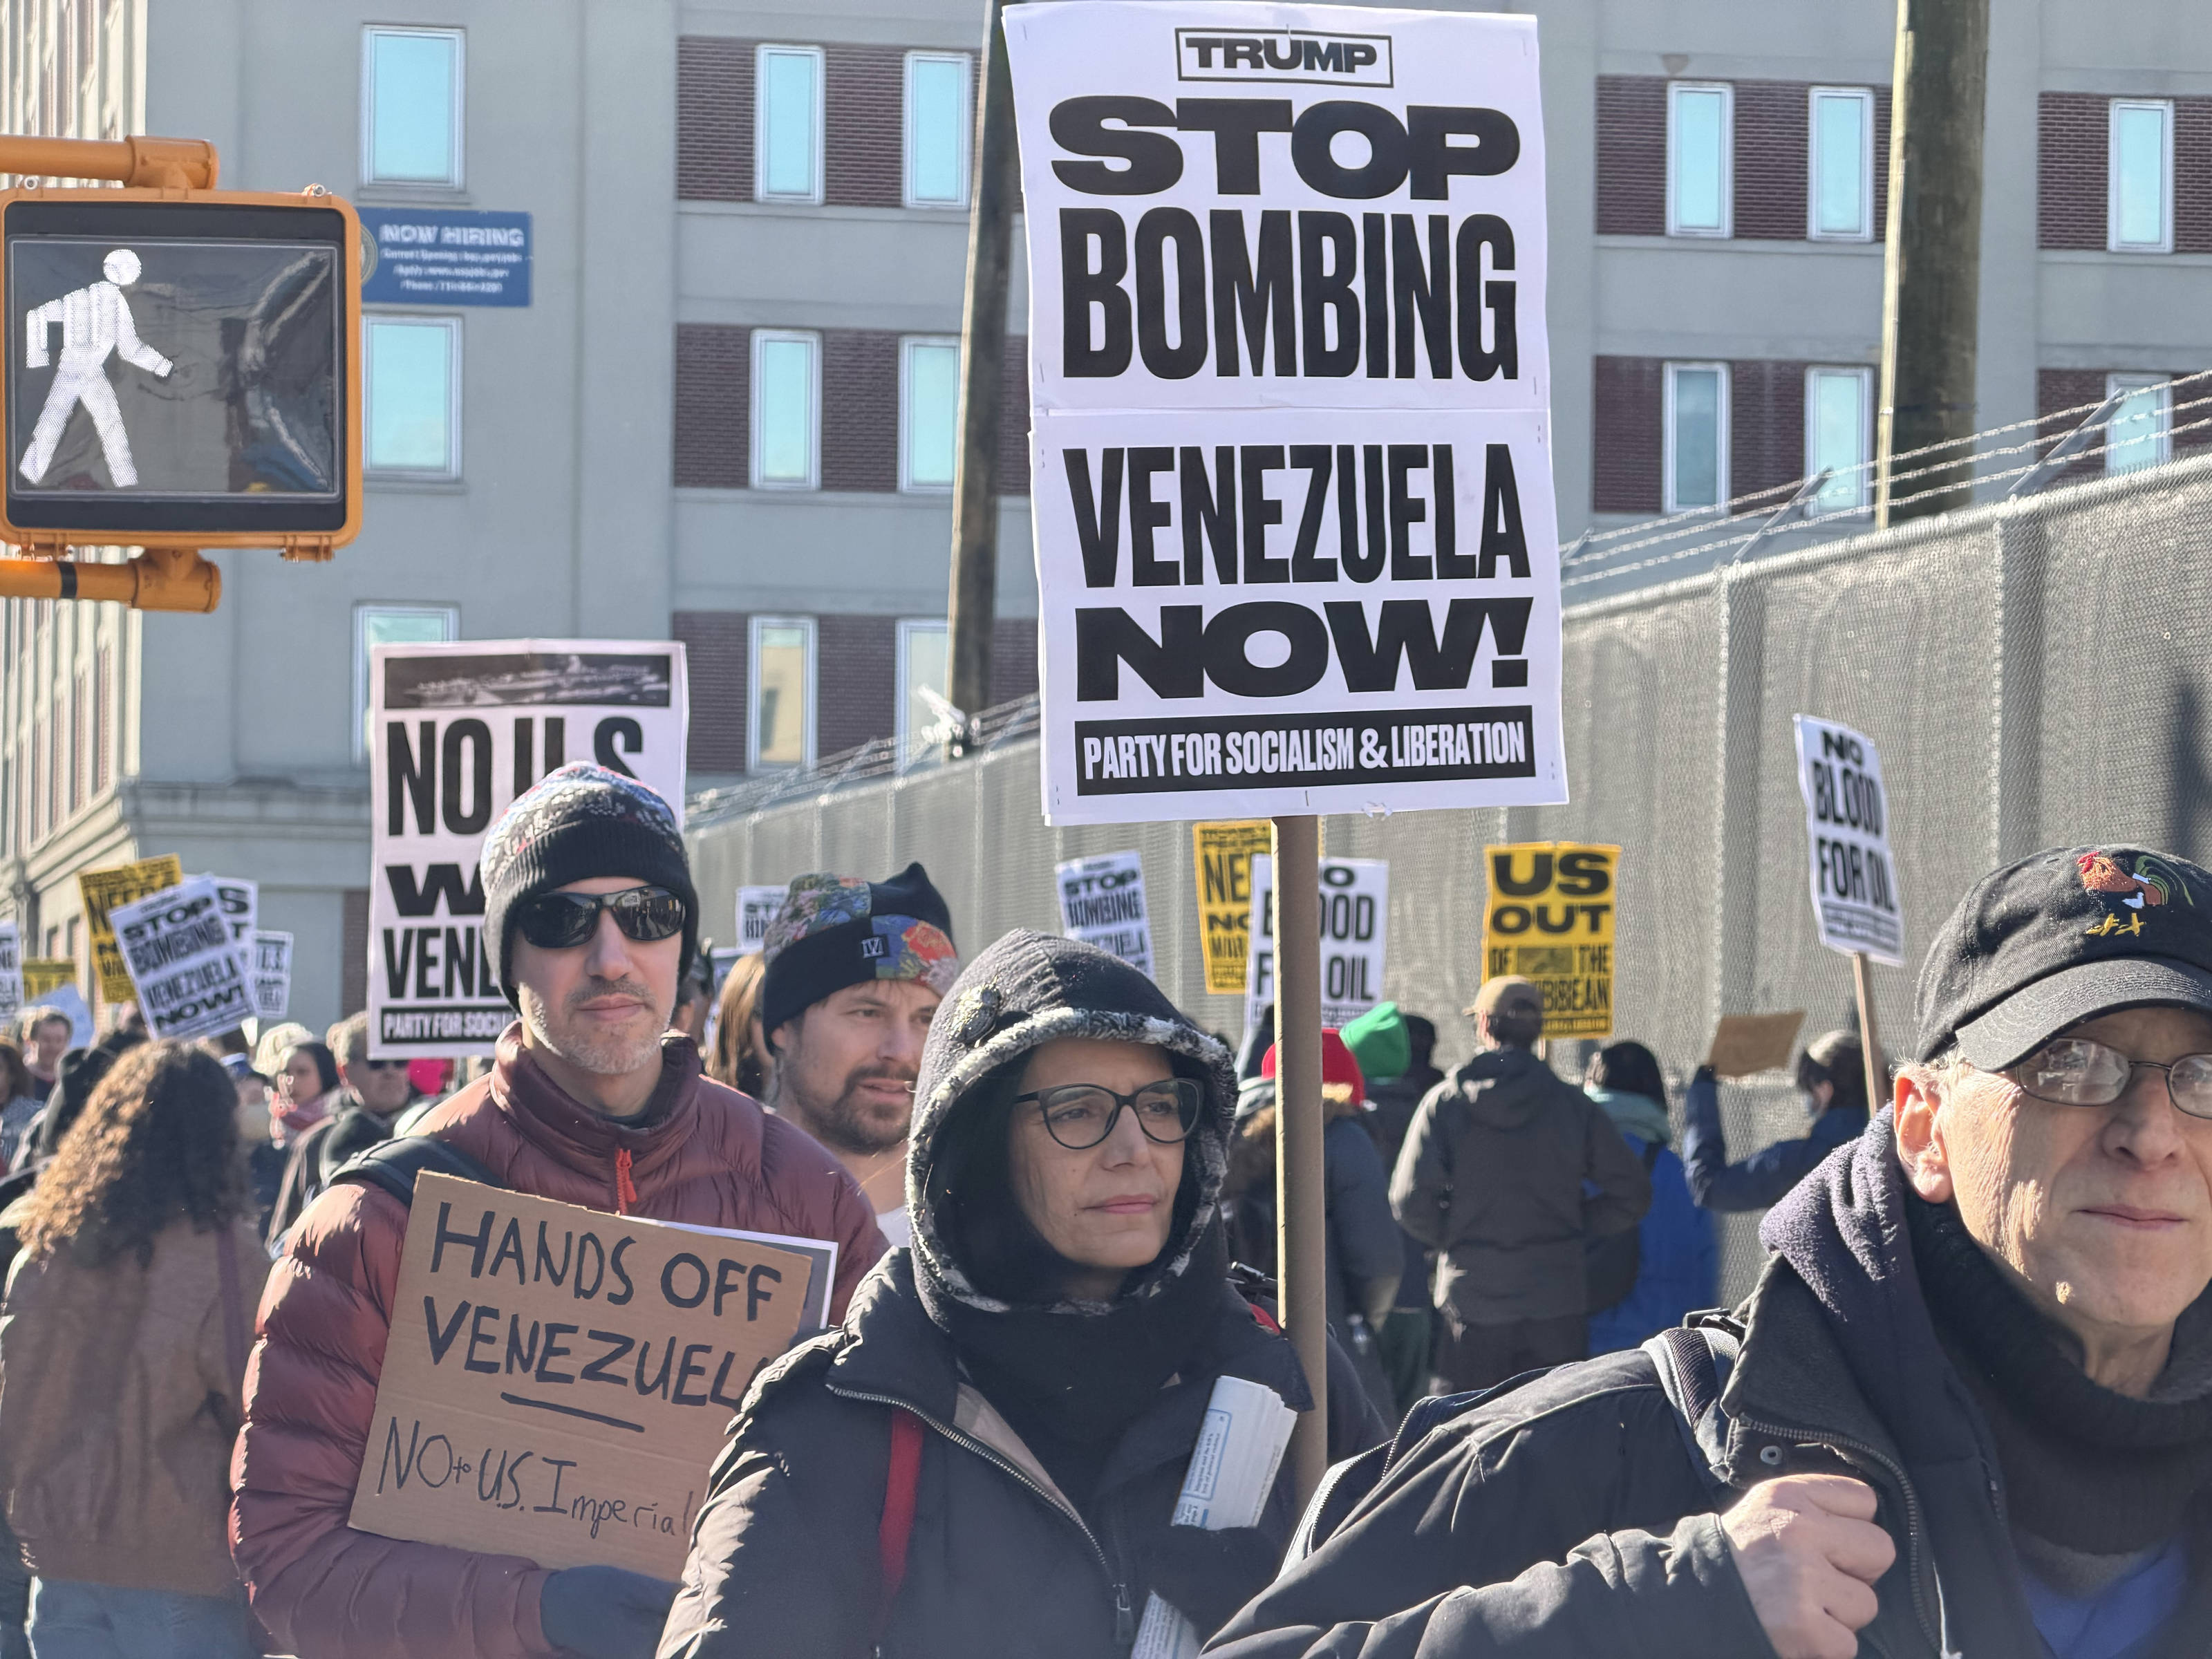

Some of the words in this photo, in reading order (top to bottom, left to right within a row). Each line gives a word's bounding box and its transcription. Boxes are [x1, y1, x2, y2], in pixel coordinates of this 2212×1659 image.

[1185, 37, 1378, 74] TRUMP
[1049, 95, 1521, 200] STOP
[380, 224, 438, 243] NOW
[440, 226, 524, 247] HIRING
[1059, 207, 1519, 382] BOMBING
[1062, 444, 1532, 588] VENEZUELA
[1075, 597, 1534, 702] NOW!
[1083, 734, 1166, 780] PARTY
[1171, 733, 1222, 776] FOR
[1226, 728, 1354, 774] SOCIALISM
[1359, 727, 1389, 769] &
[1391, 721, 1526, 767] LIBERATION
[1821, 730, 1864, 766] NO
[386, 718, 493, 836] NO
[1812, 759, 1883, 836] BLOOD
[1065, 869, 1137, 895] STOP
[1494, 852, 1610, 897] US
[1817, 838, 1866, 899] FOR
[122, 896, 212, 940] STOP
[1492, 904, 1611, 934] OUT
[1327, 955, 1374, 1000] OIL
[1579, 944, 1609, 973] THE
[1537, 977, 1610, 1011] BBEAN
[383, 1011, 433, 1038] PARTY
[432, 1011, 463, 1038] FOR
[430, 1201, 637, 1305] HANDS
[660, 1252, 782, 1321] OFF
[424, 1295, 769, 1412] VENEZUEL
[377, 1416, 453, 1494] NO
[453, 1456, 471, 1483] to
